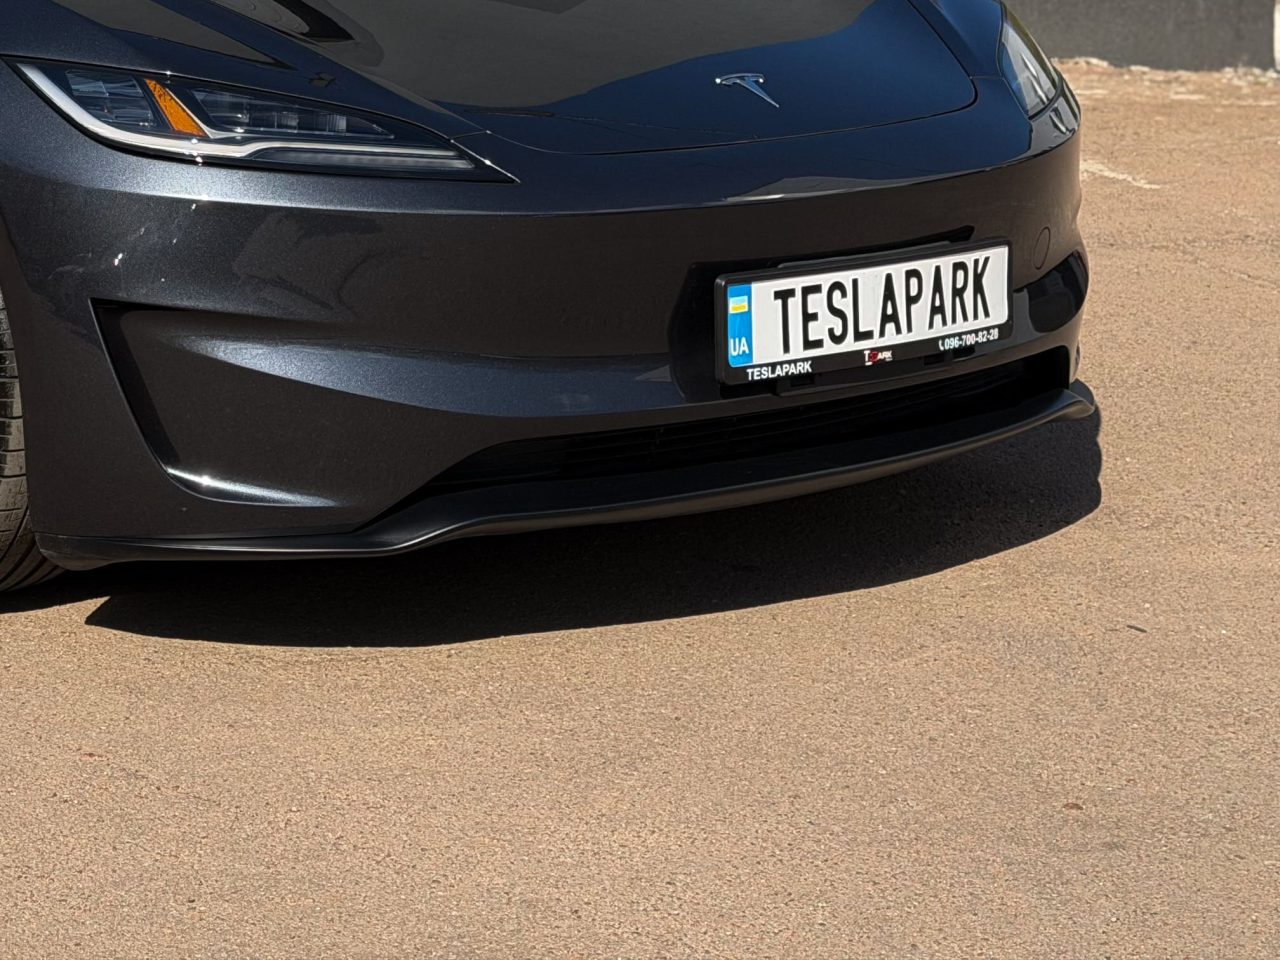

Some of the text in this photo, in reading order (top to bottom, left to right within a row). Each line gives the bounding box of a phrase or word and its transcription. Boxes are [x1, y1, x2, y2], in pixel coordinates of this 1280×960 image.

[774, 255, 991, 355] TESLAPARK
[730, 336, 749, 356] UA
[746, 360, 813, 381] TESLAPARK
